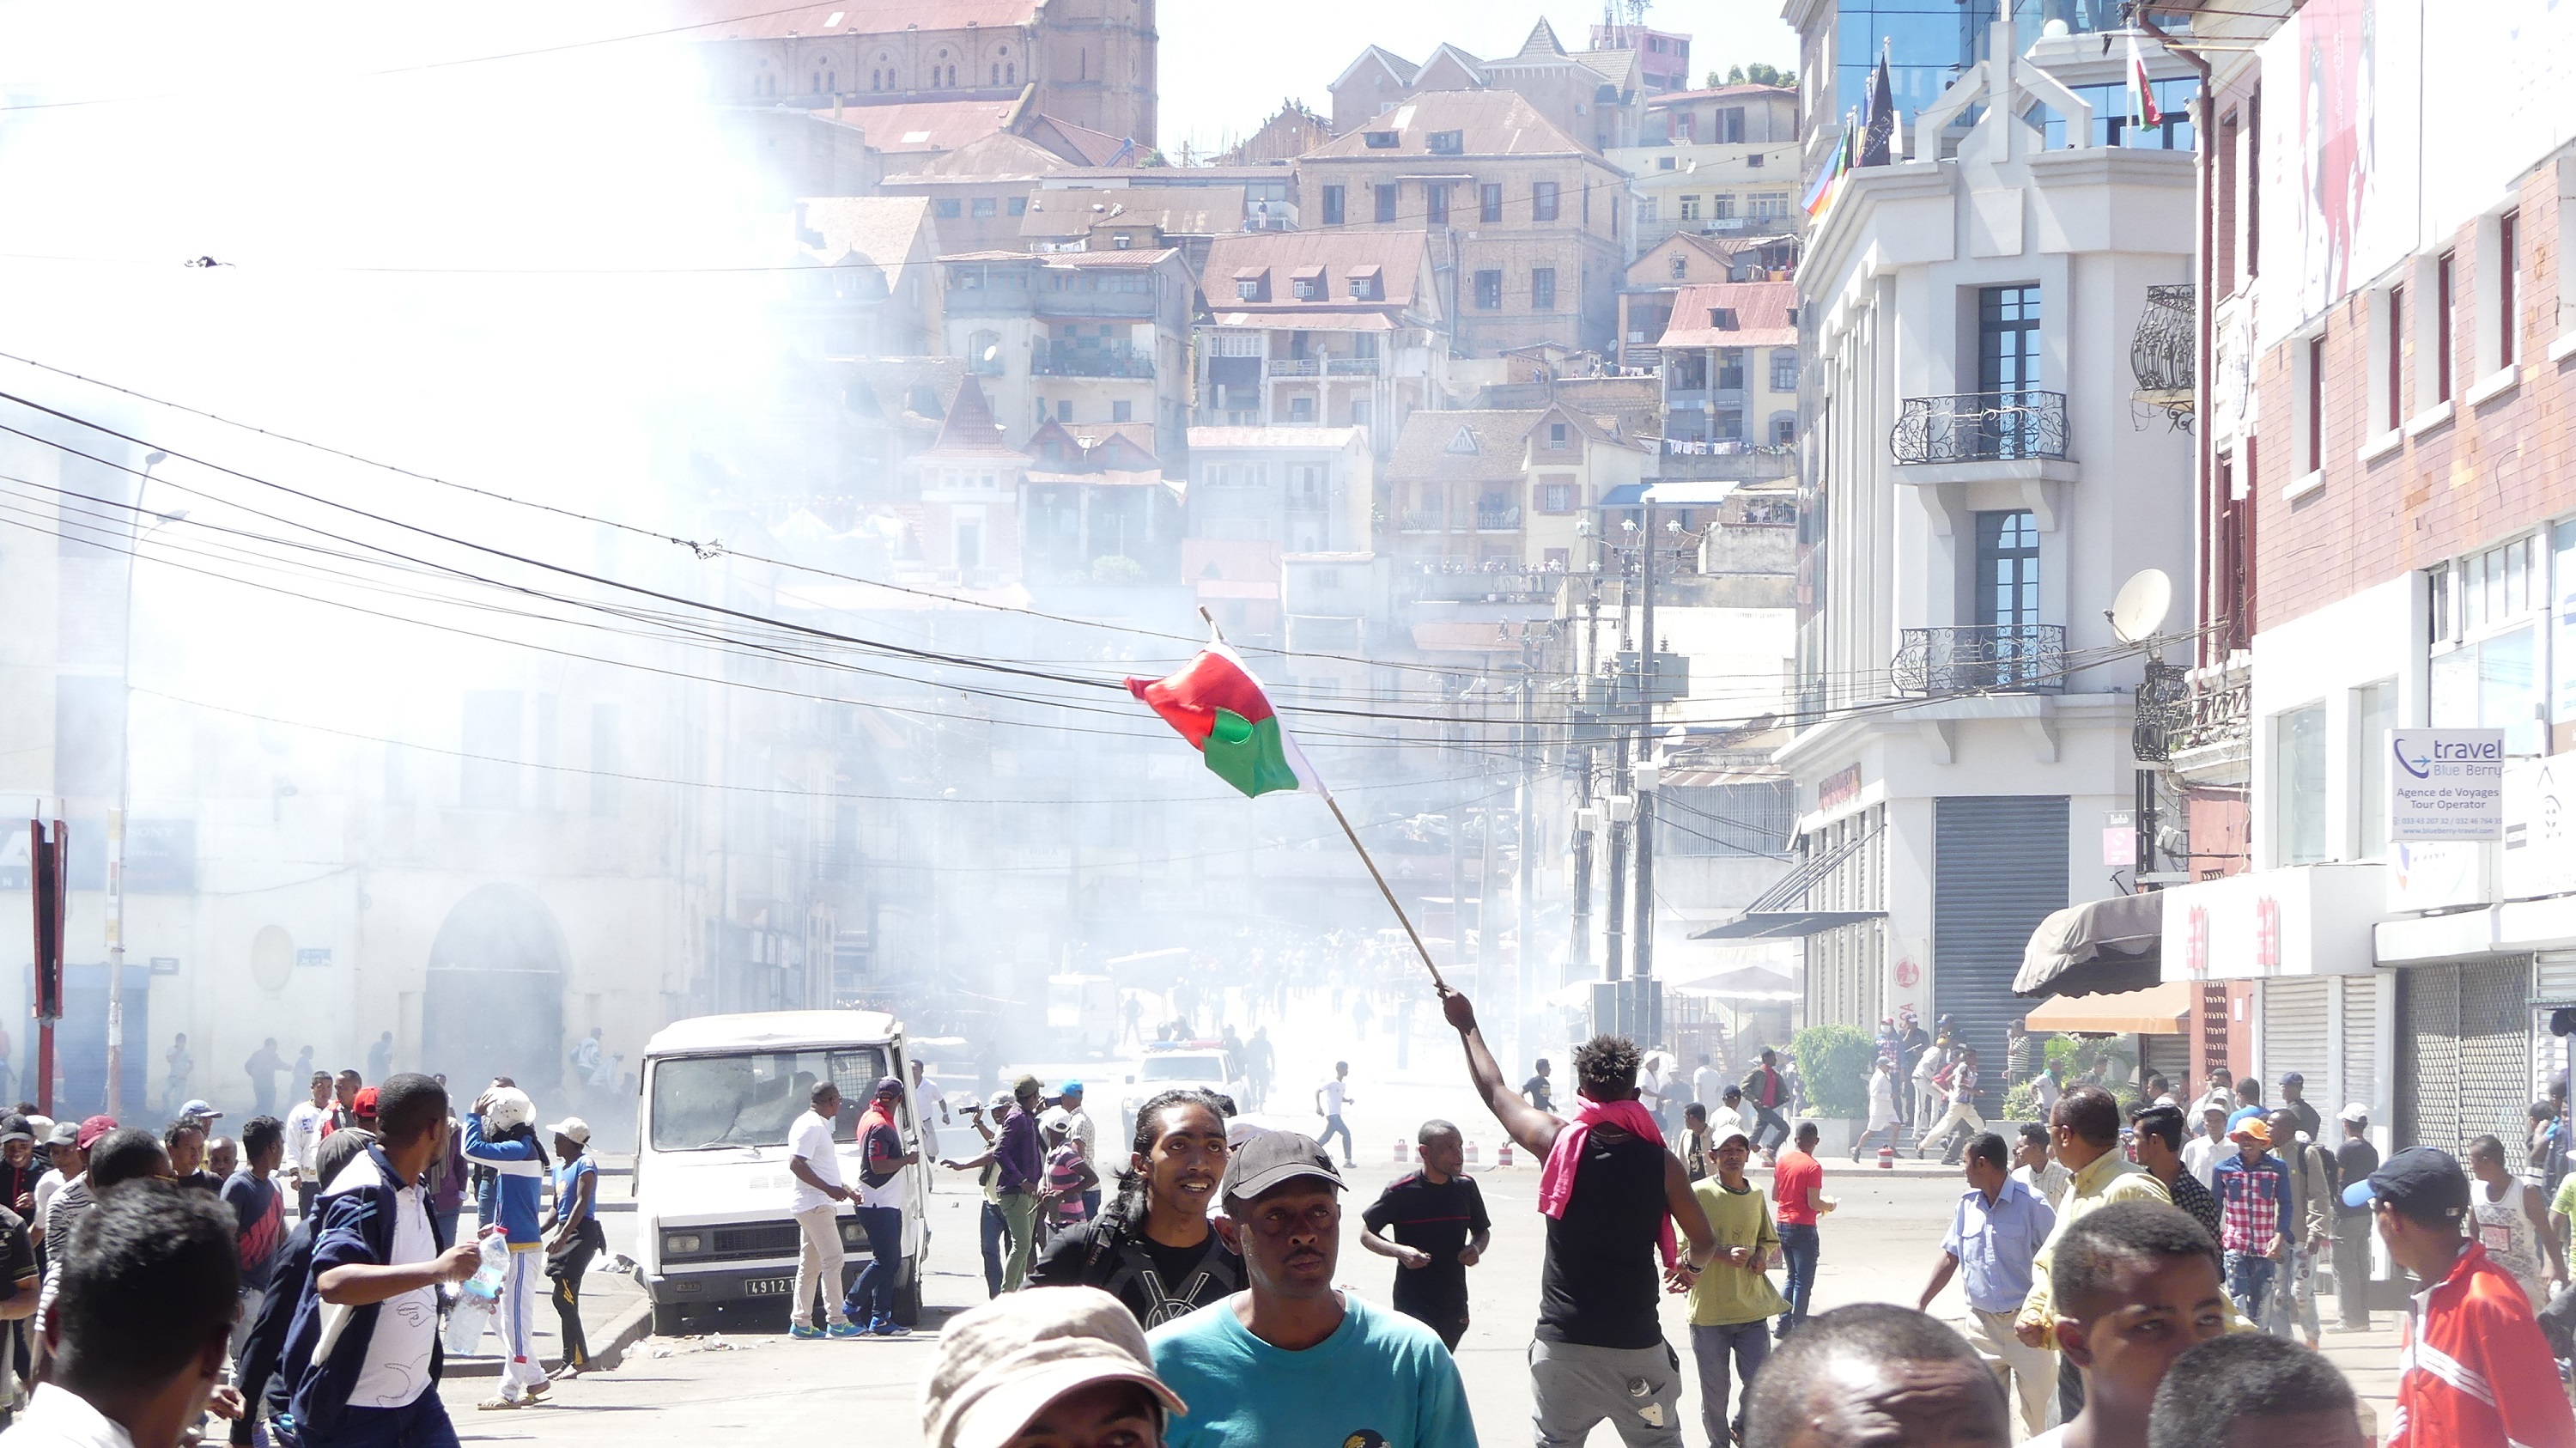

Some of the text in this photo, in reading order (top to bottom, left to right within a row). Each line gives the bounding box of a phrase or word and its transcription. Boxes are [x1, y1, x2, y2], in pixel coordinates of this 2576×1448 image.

[2434, 739, 2501, 758] travel
[2433, 764, 2501, 778] Blue Berry
[2397, 788, 2500, 799] Agence de Voyages
[2410, 800, 2486, 811] Tour Operator
[126, 827, 174, 837] SONY
[751, 1280, 786, 1294] 4912
